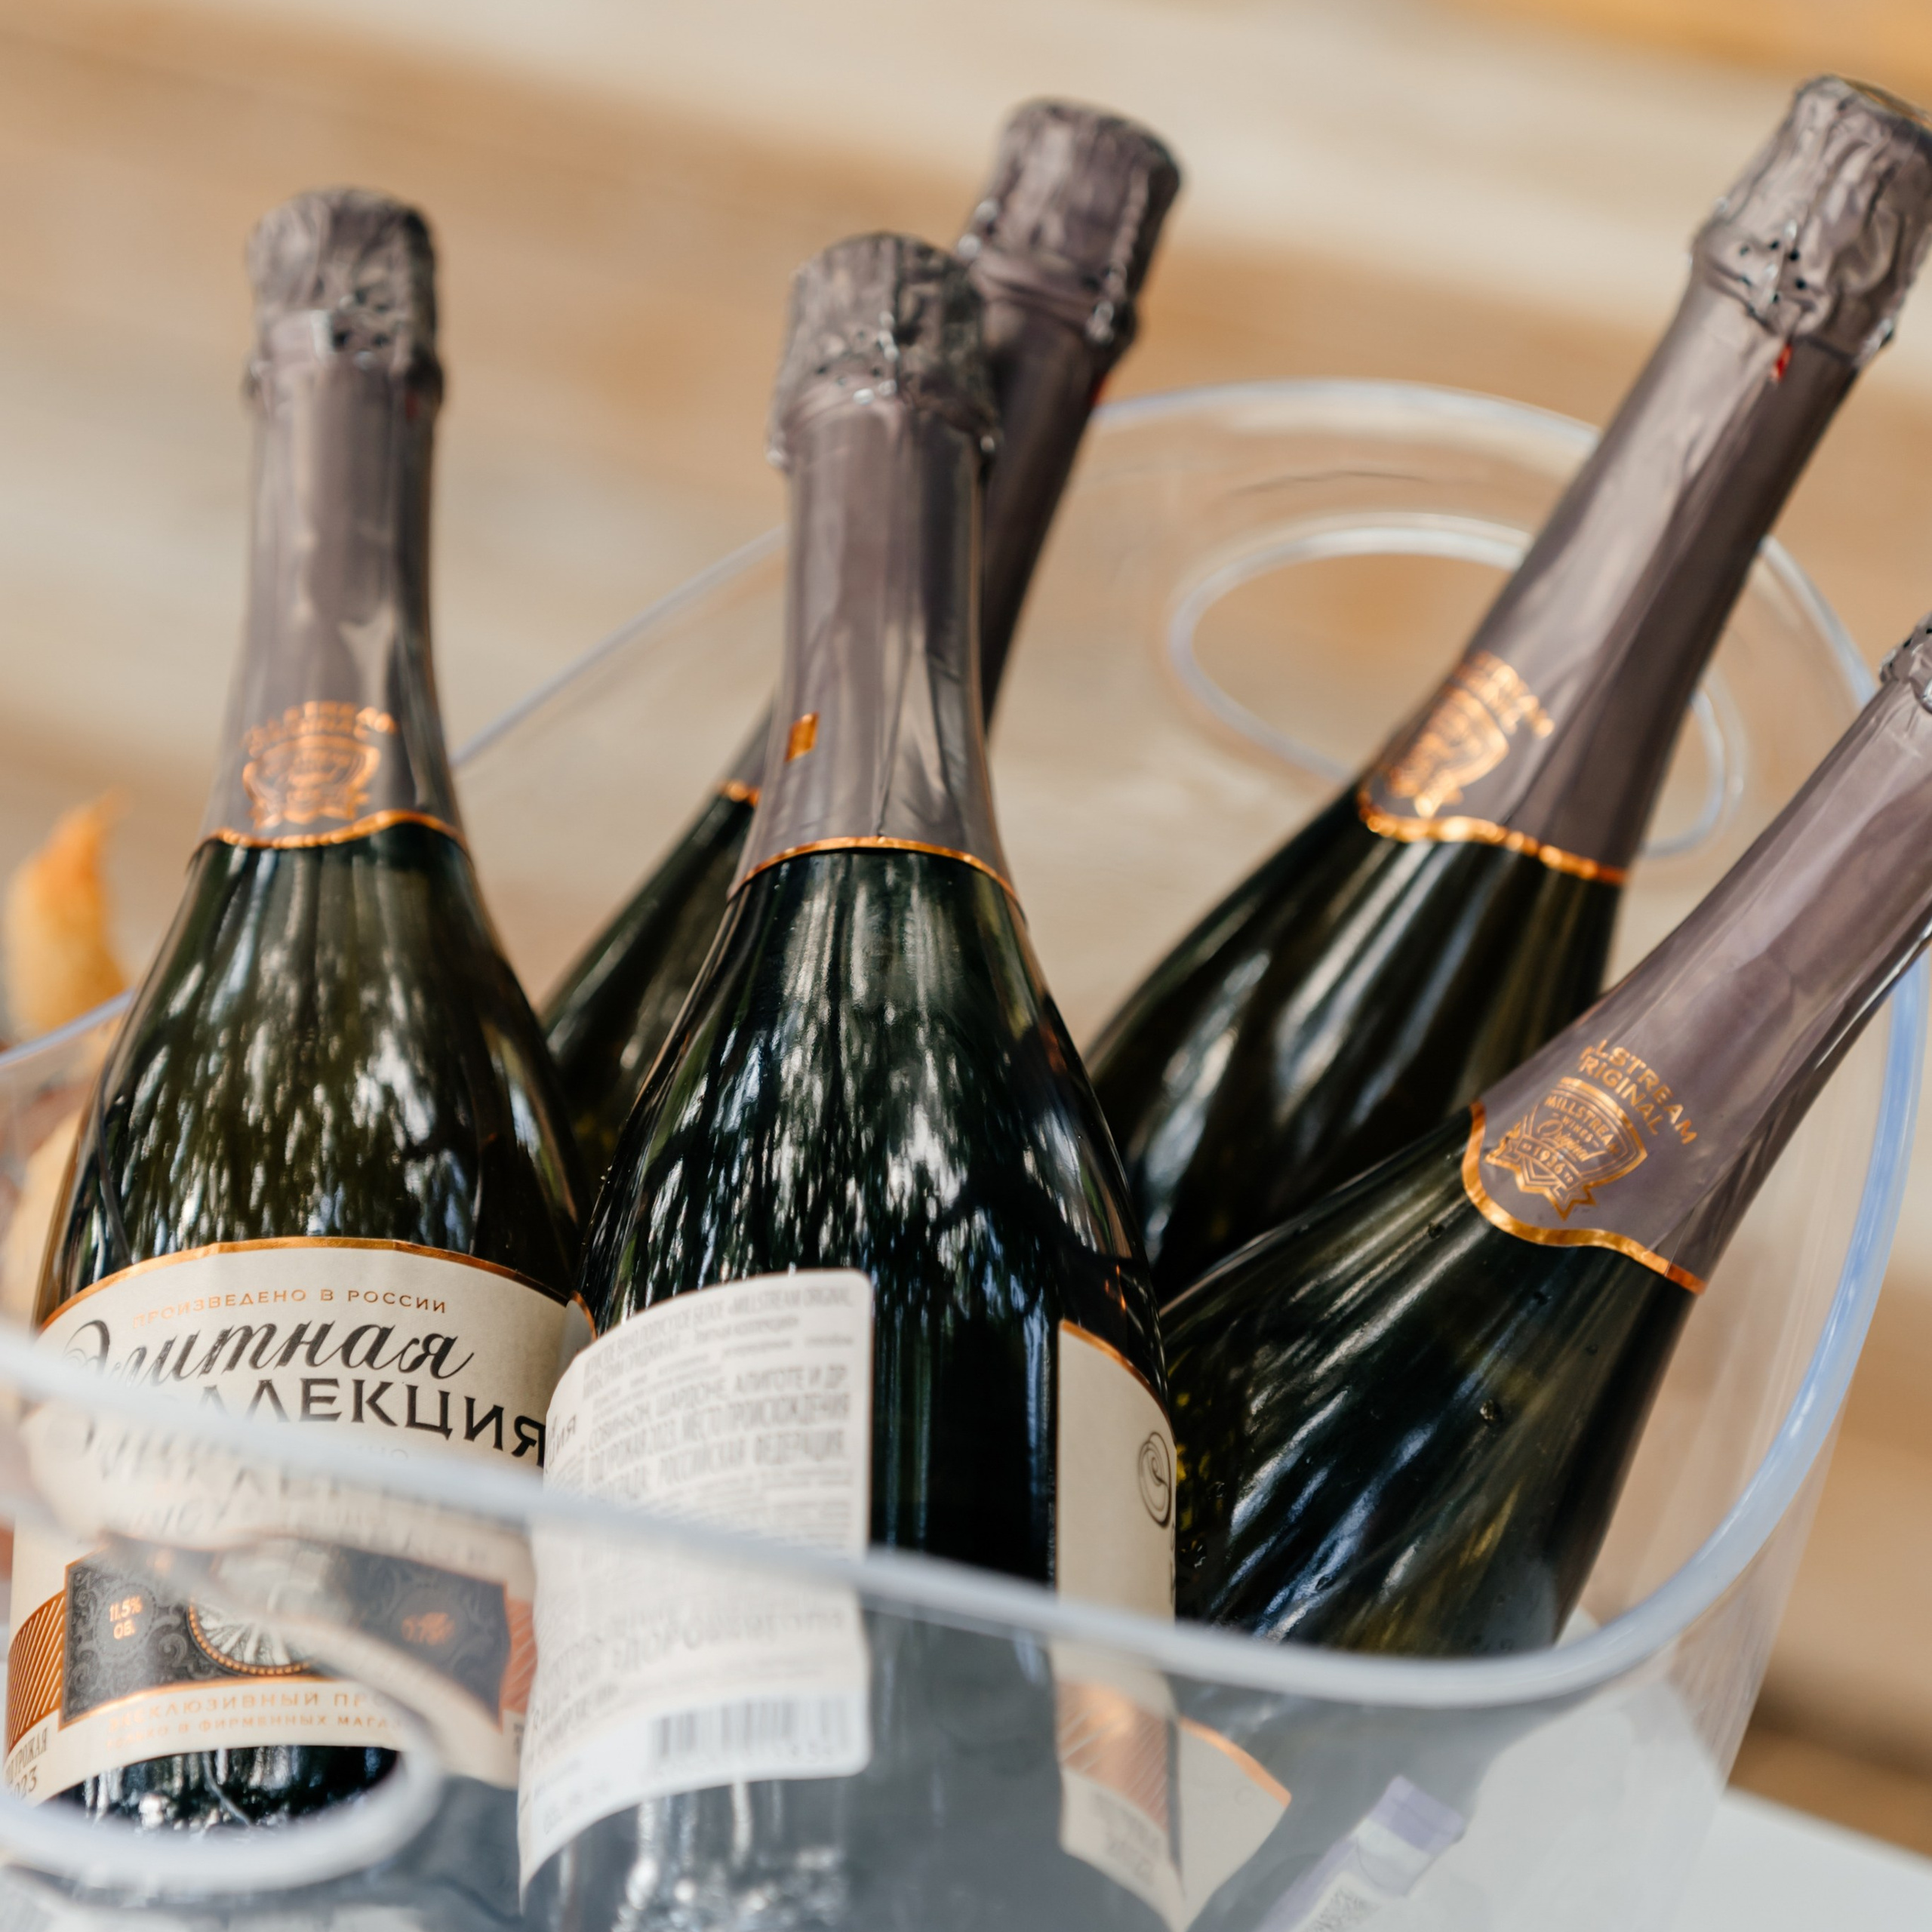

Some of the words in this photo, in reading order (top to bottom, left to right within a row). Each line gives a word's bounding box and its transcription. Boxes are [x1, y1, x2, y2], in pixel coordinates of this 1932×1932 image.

[1579, 1055, 1663, 1135] RIGINAL
[132, 1288, 307, 1330] ПРОИЗВЕДЕНО
[320, 1288, 334, 1302] В
[347, 1289, 446, 1314] РОССИИ
[195, 1377, 546, 1469] ЛЛЕКЦИЯ
